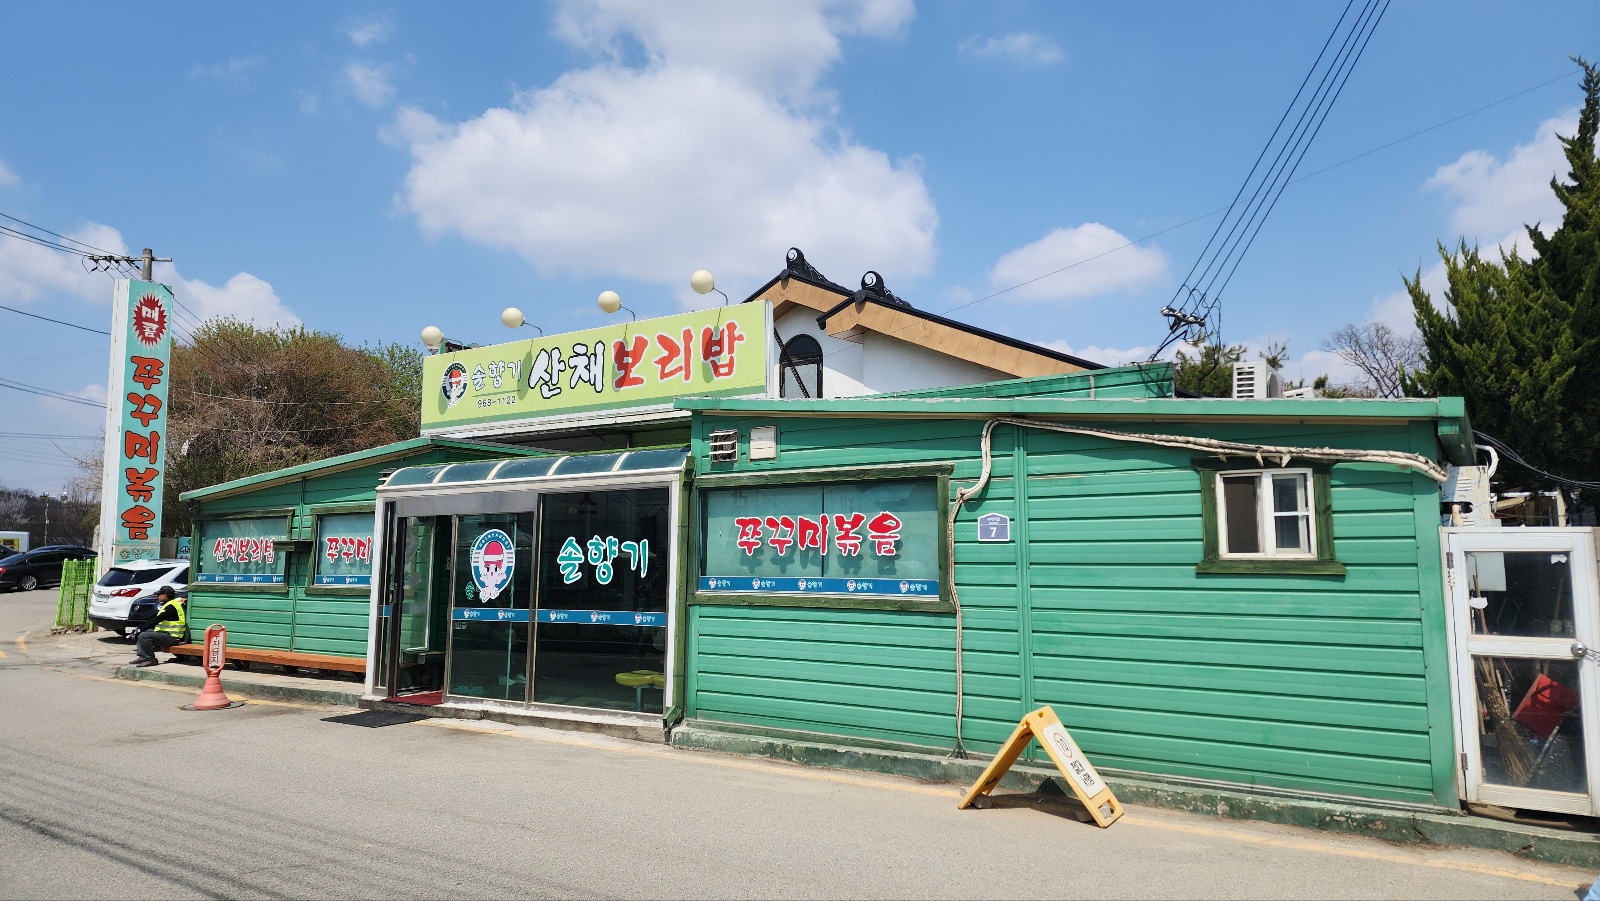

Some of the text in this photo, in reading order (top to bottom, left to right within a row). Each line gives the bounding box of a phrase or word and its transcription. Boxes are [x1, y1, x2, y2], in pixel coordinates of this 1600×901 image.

[142, 305, 159, 338] 매콤
[471, 359, 522, 391] 솔향기
[528, 319, 745, 399] 산채보리밥
[121, 355, 164, 540] 쭈꾸미볶음
[734, 511, 902, 556] 쭈꾸미볶음
[989, 526, 997, 538] 7
[119, 547, 154, 559] 솔향기
[213, 537, 277, 563] 산채보리밥
[557, 534, 649, 585] 솔향기
